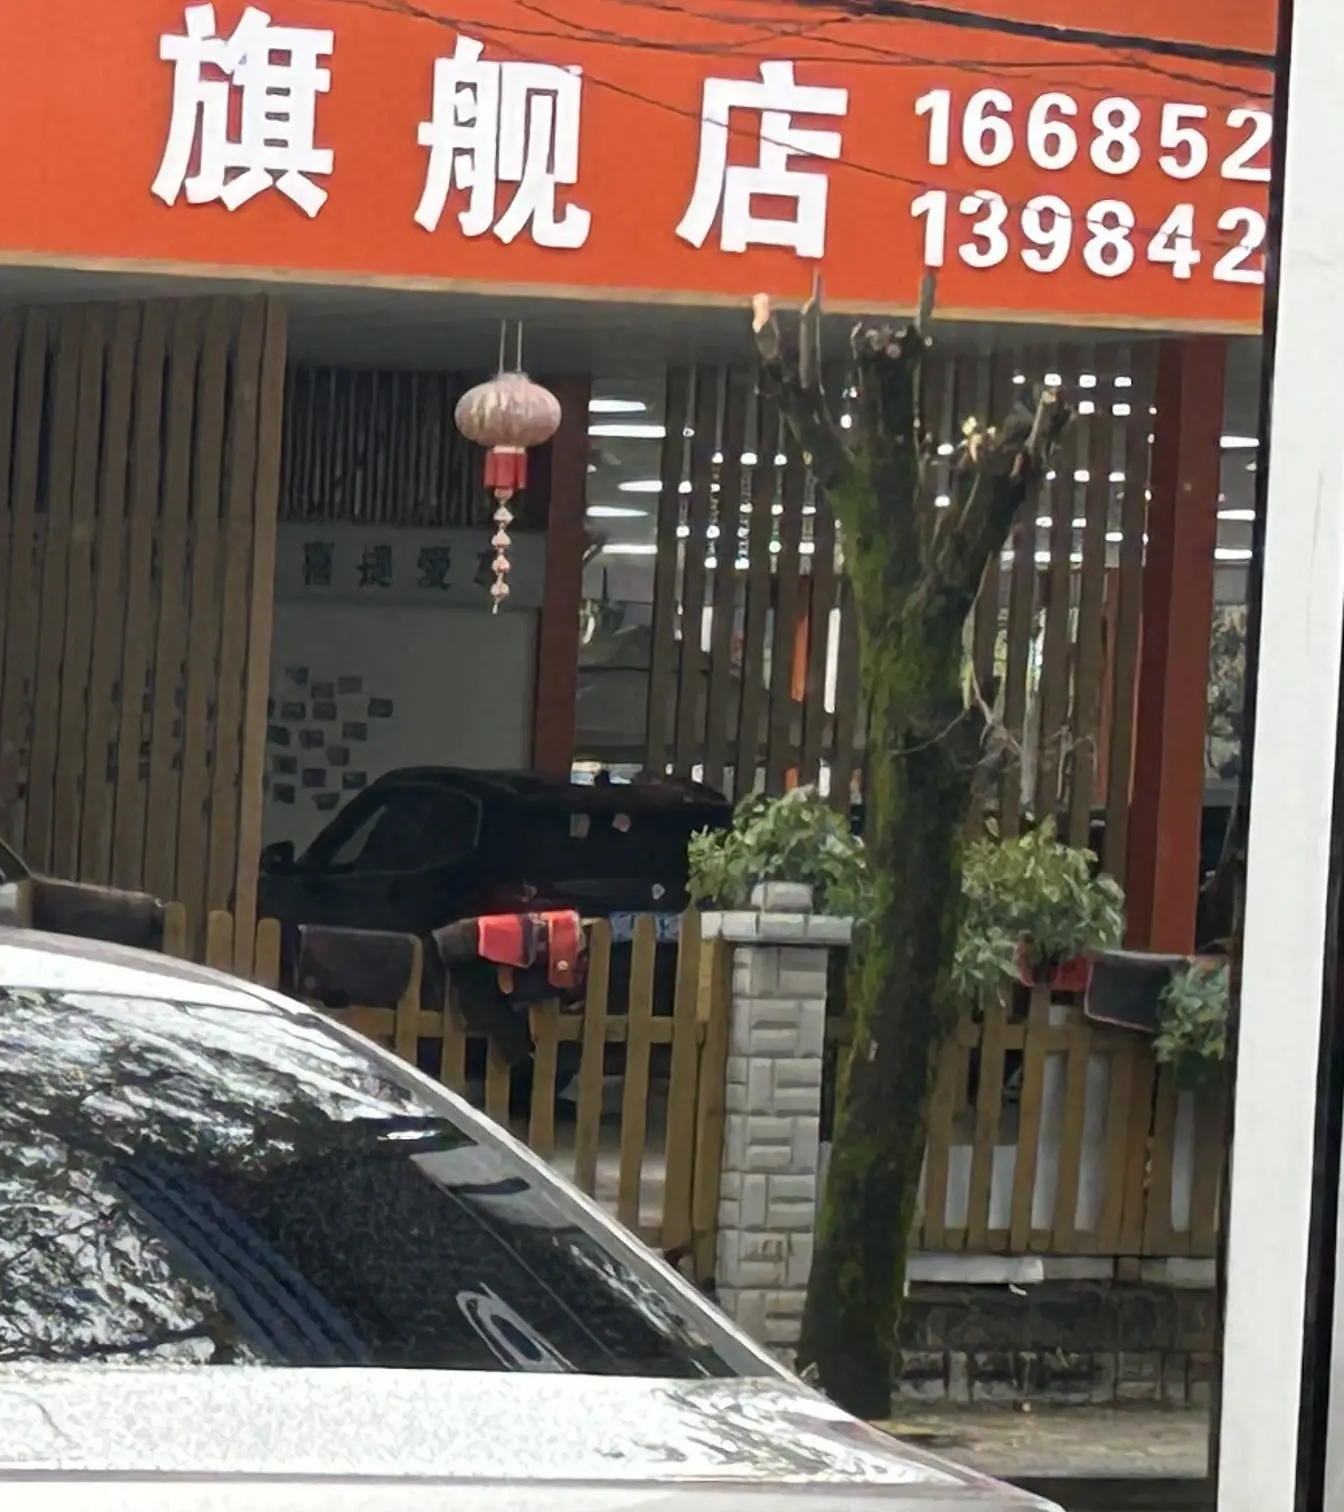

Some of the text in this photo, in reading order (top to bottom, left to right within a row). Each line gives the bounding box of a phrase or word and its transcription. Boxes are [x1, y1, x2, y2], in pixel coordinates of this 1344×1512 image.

[151, 3, 849, 259] 旗舰店
[915, 88, 1273, 182] 166852
[911, 189, 1266, 285] 139842
